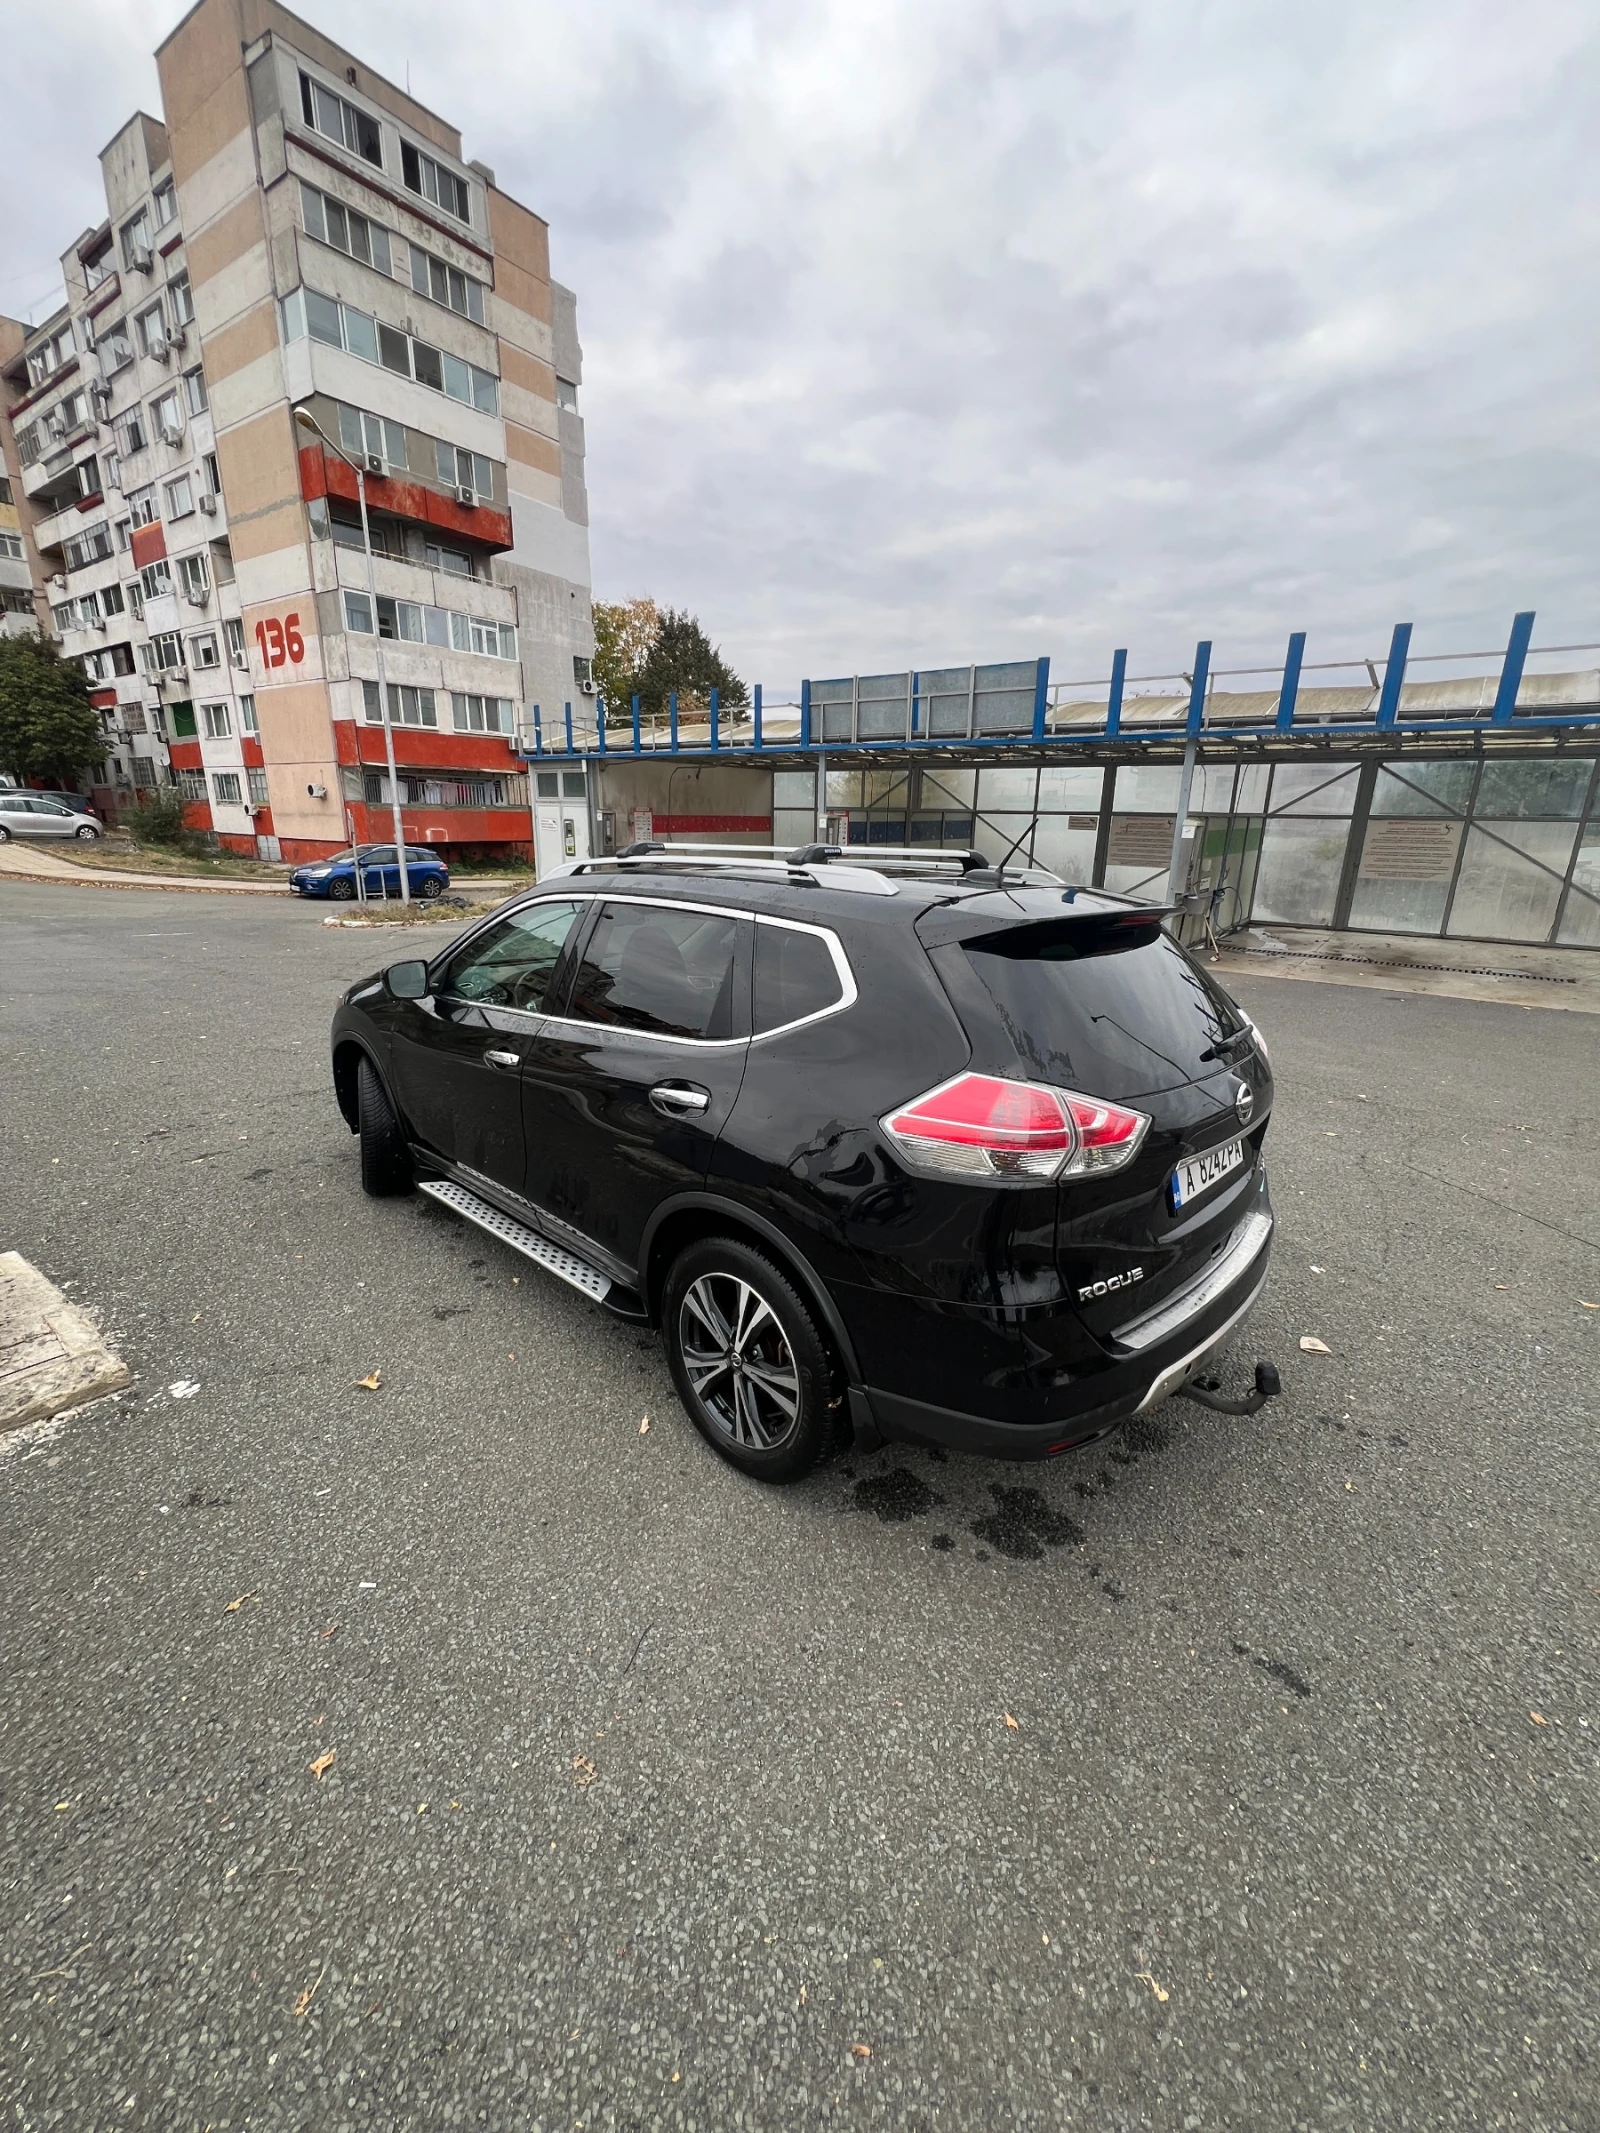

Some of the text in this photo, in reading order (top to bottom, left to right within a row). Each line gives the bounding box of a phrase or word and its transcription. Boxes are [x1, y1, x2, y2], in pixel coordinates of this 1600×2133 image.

[255, 612, 305, 670] 136
[1186, 1165, 1195, 1195] A
[1077, 1266, 1144, 1302] ROGUE
